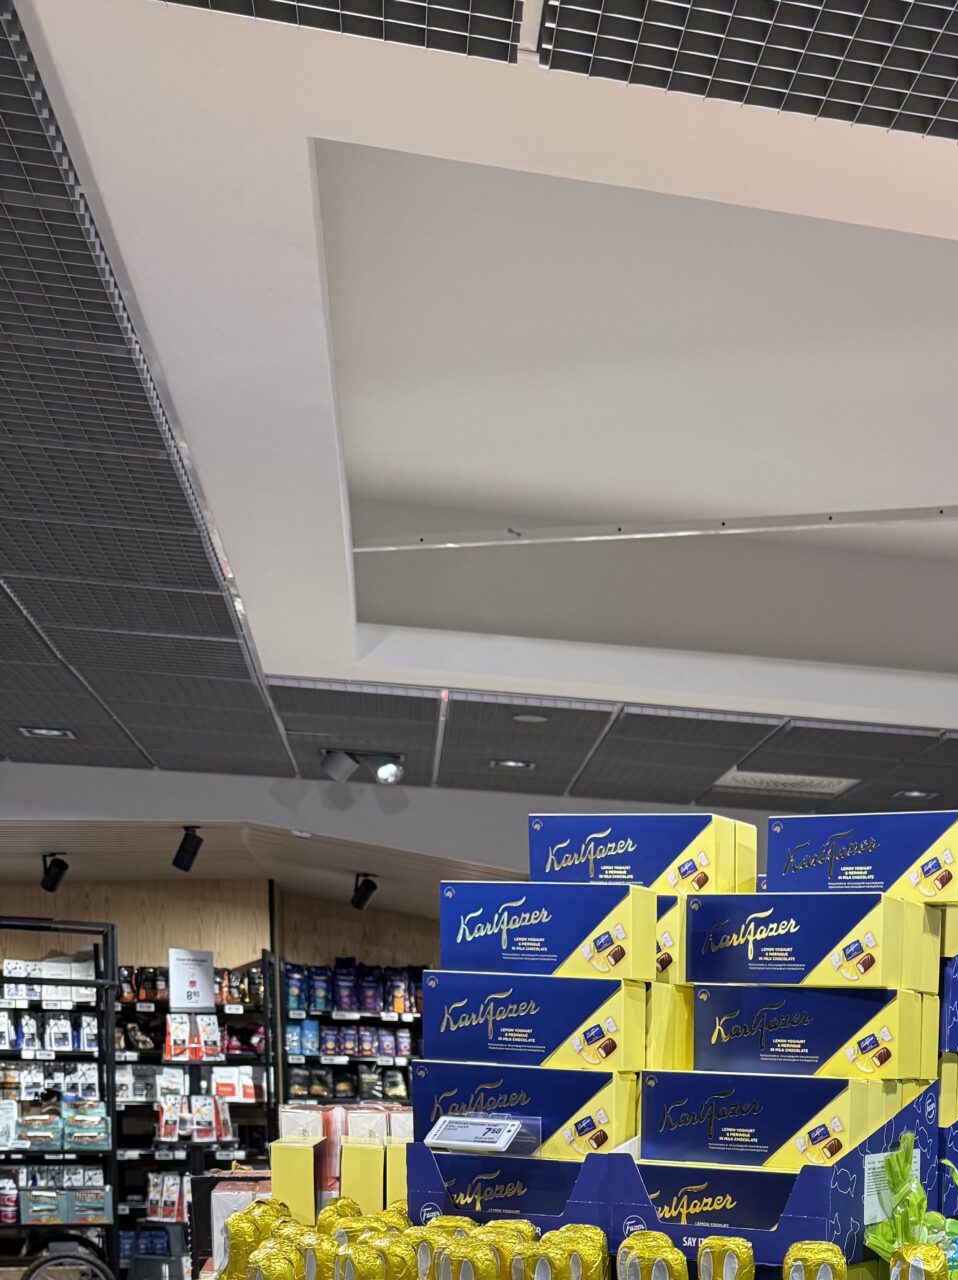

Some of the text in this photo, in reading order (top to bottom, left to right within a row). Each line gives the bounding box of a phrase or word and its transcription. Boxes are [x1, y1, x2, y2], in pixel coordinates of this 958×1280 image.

[546, 827, 637, 878] Karl Fazer
[457, 896, 552, 950] Karl Fazer
[746, 907, 800, 960] Fazer
[440, 988, 540, 1040] Karl Fazer
[678, 1182, 737, 1225] Fazer
[683, 1236, 697, 1246] SAY
